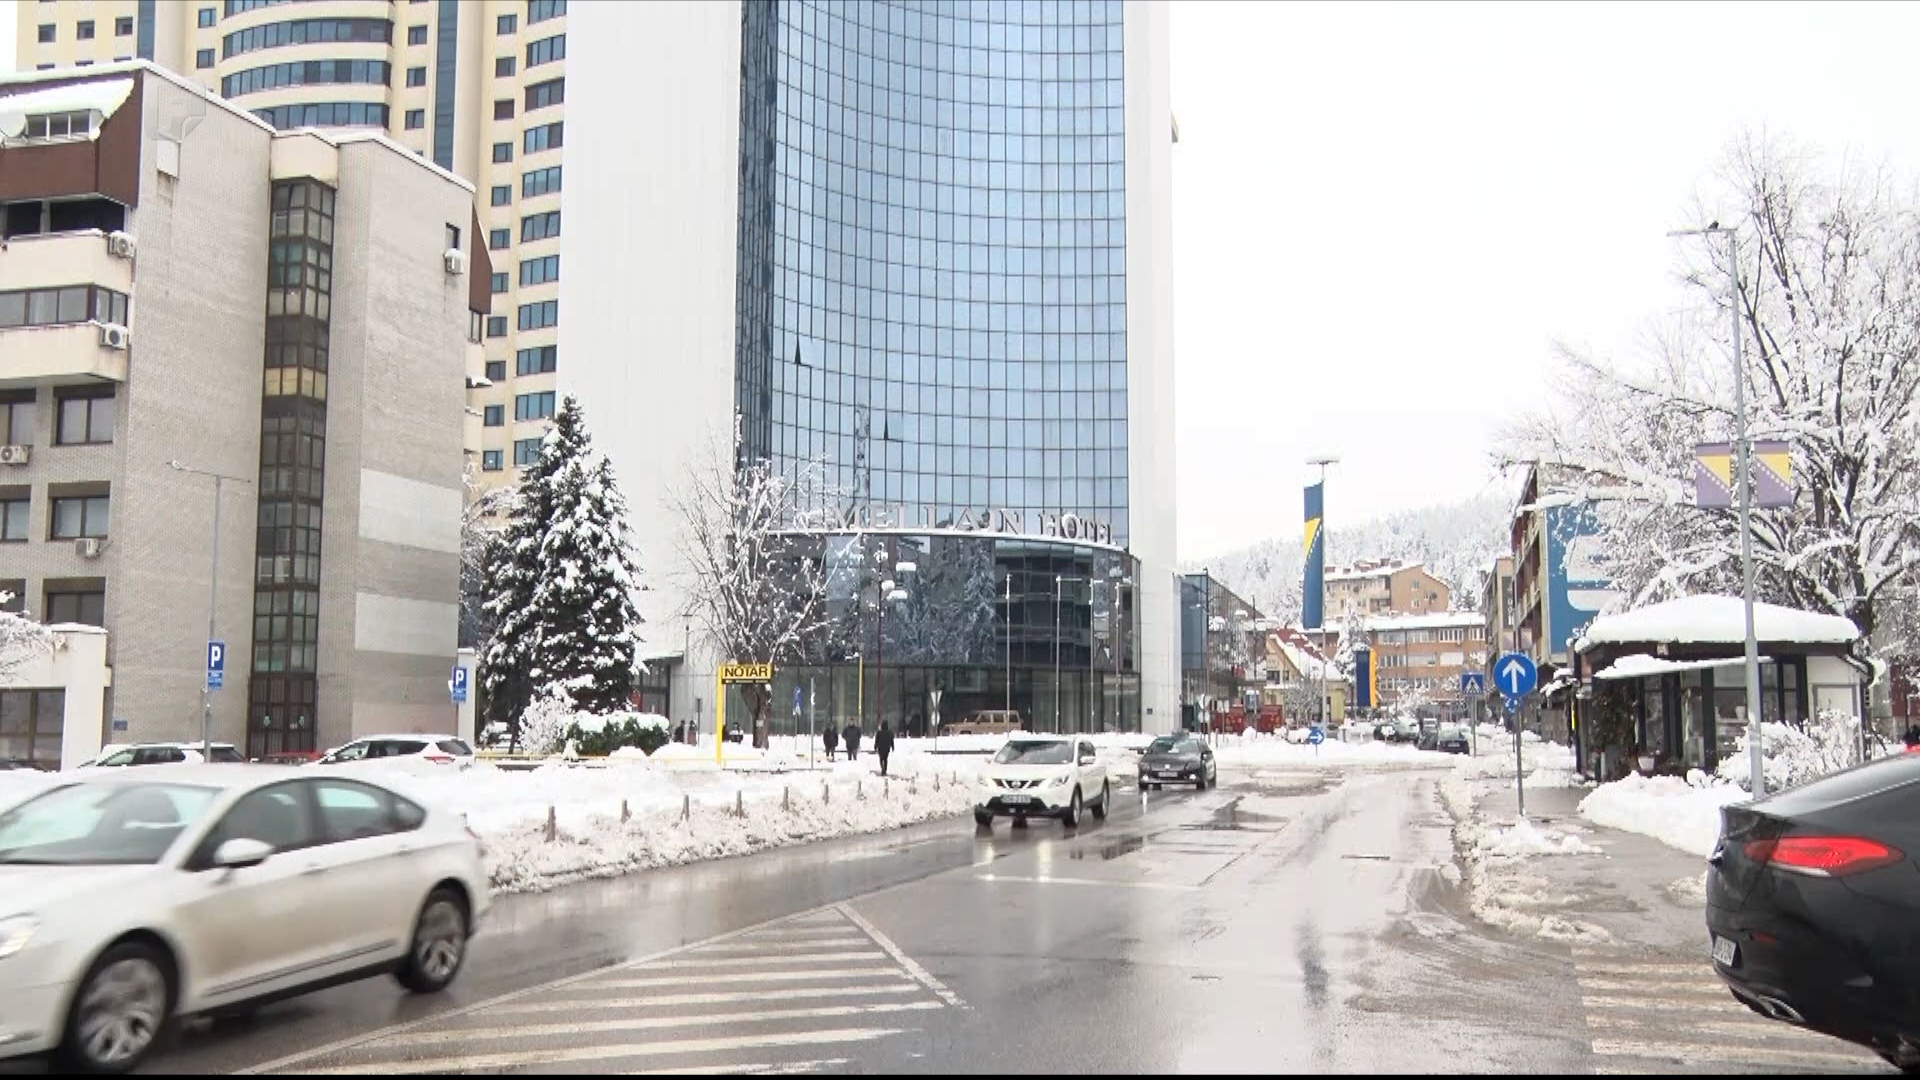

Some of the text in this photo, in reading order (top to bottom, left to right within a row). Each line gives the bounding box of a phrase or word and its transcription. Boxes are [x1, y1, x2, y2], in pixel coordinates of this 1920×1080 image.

[1038, 509, 1116, 544] HOTEL
[211, 645, 221, 668] P
[455, 669, 464, 685] P
[725, 667, 769, 677] NOTAR
